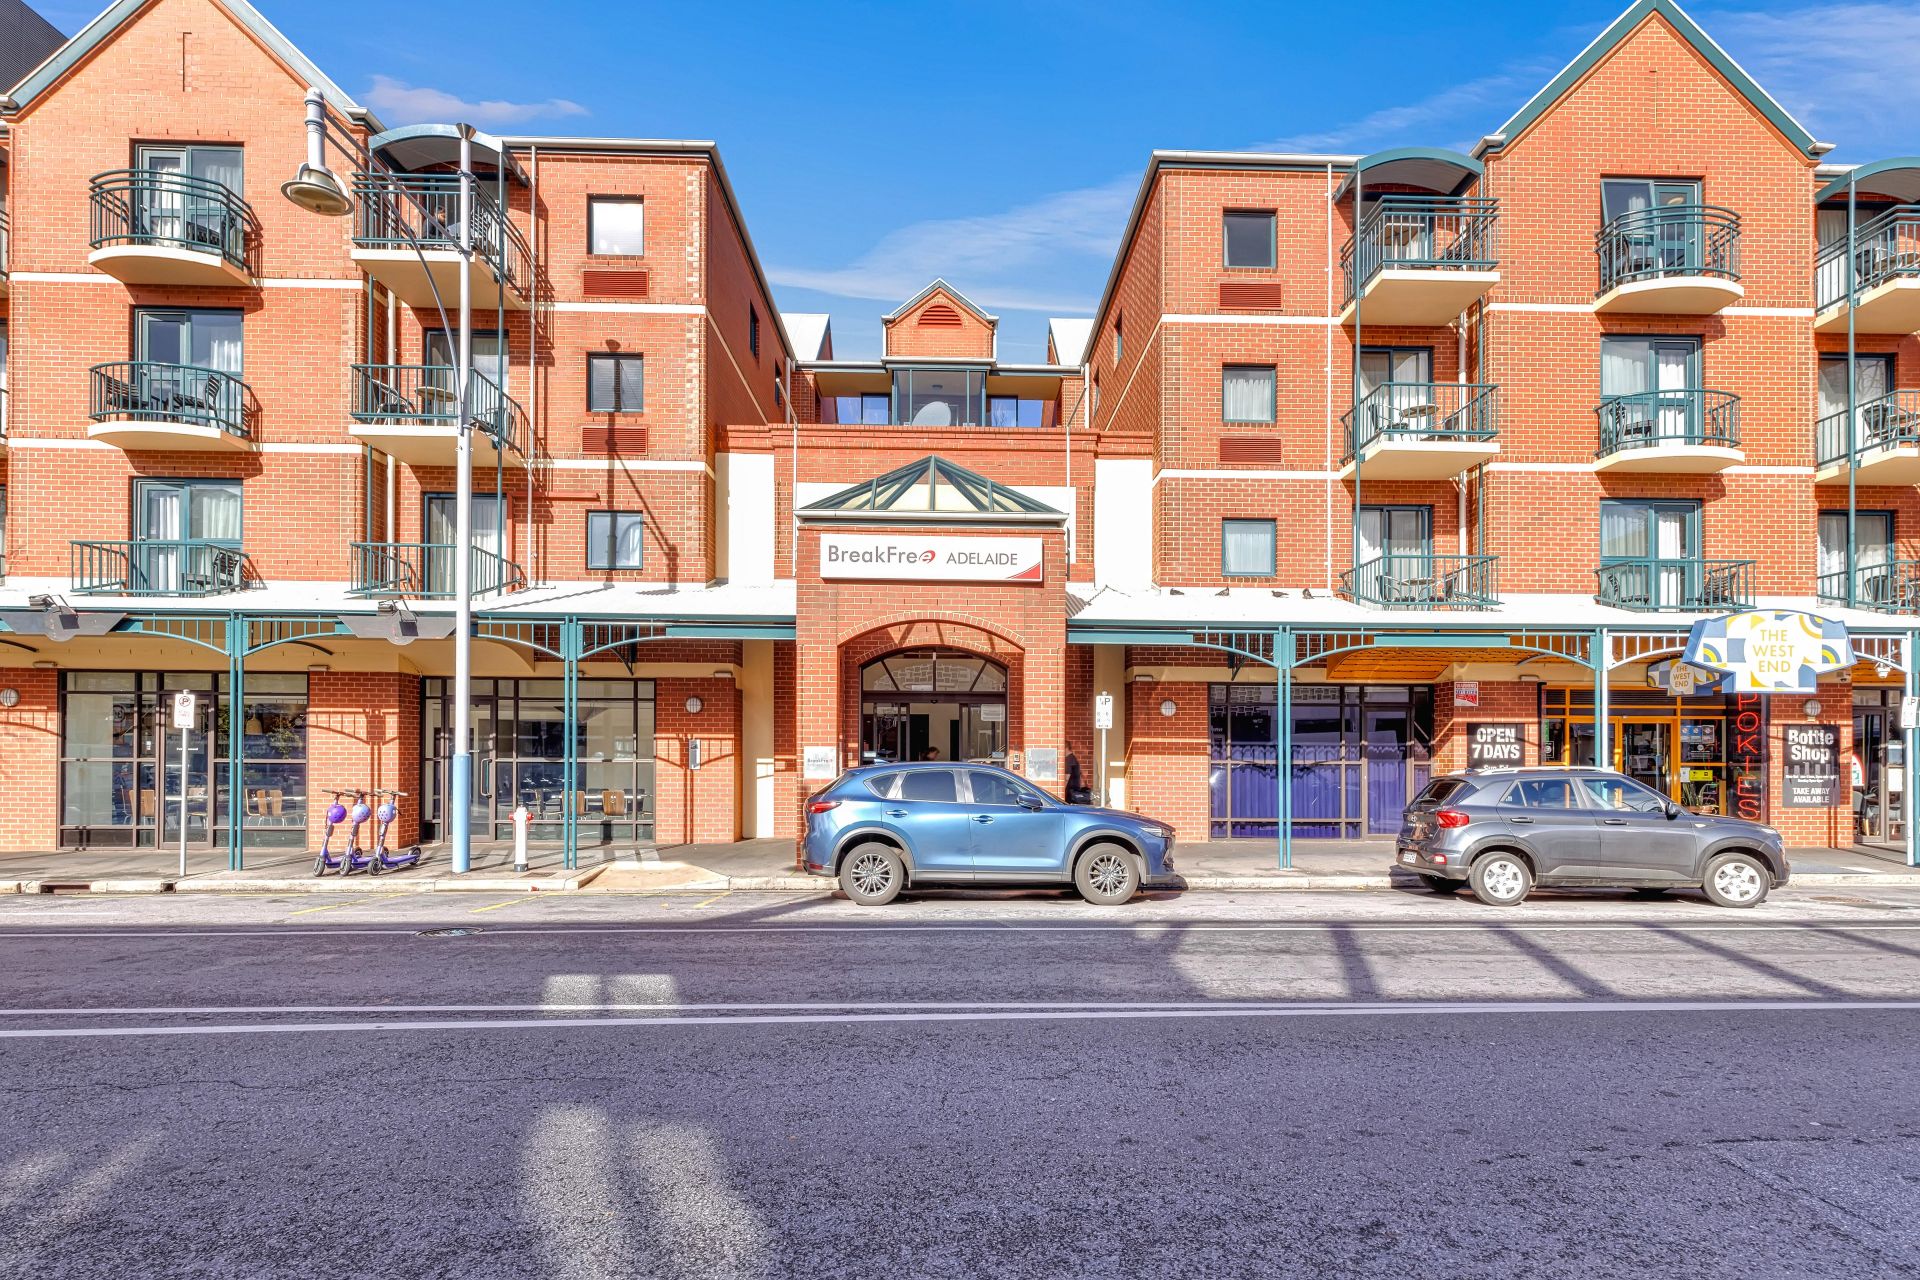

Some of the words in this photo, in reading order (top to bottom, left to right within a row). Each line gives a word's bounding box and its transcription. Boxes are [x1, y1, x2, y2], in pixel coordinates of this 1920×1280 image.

[828, 544, 936, 564] BreakFree
[946, 552, 1018, 565] ADELAIDE
[1760, 629, 1788, 642] THE
[1753, 644, 1796, 657] WEST
[1676, 665, 1688, 673] THE
[1758, 660, 1791, 673] END
[1672, 672, 1691, 681] WEST
[1674, 680, 1689, 688] END
[1476, 728, 1516, 743] OPEN
[1788, 729, 1834, 745] Bottle
[1472, 744, 1482, 759] 7
[1483, 744, 1520, 759] DAYS
[1737, 692, 1760, 820] POKIES
[1791, 744, 1830, 764] Shop
[1792, 787, 1810, 795] TAKE
[1811, 787, 1830, 795] AWAY
